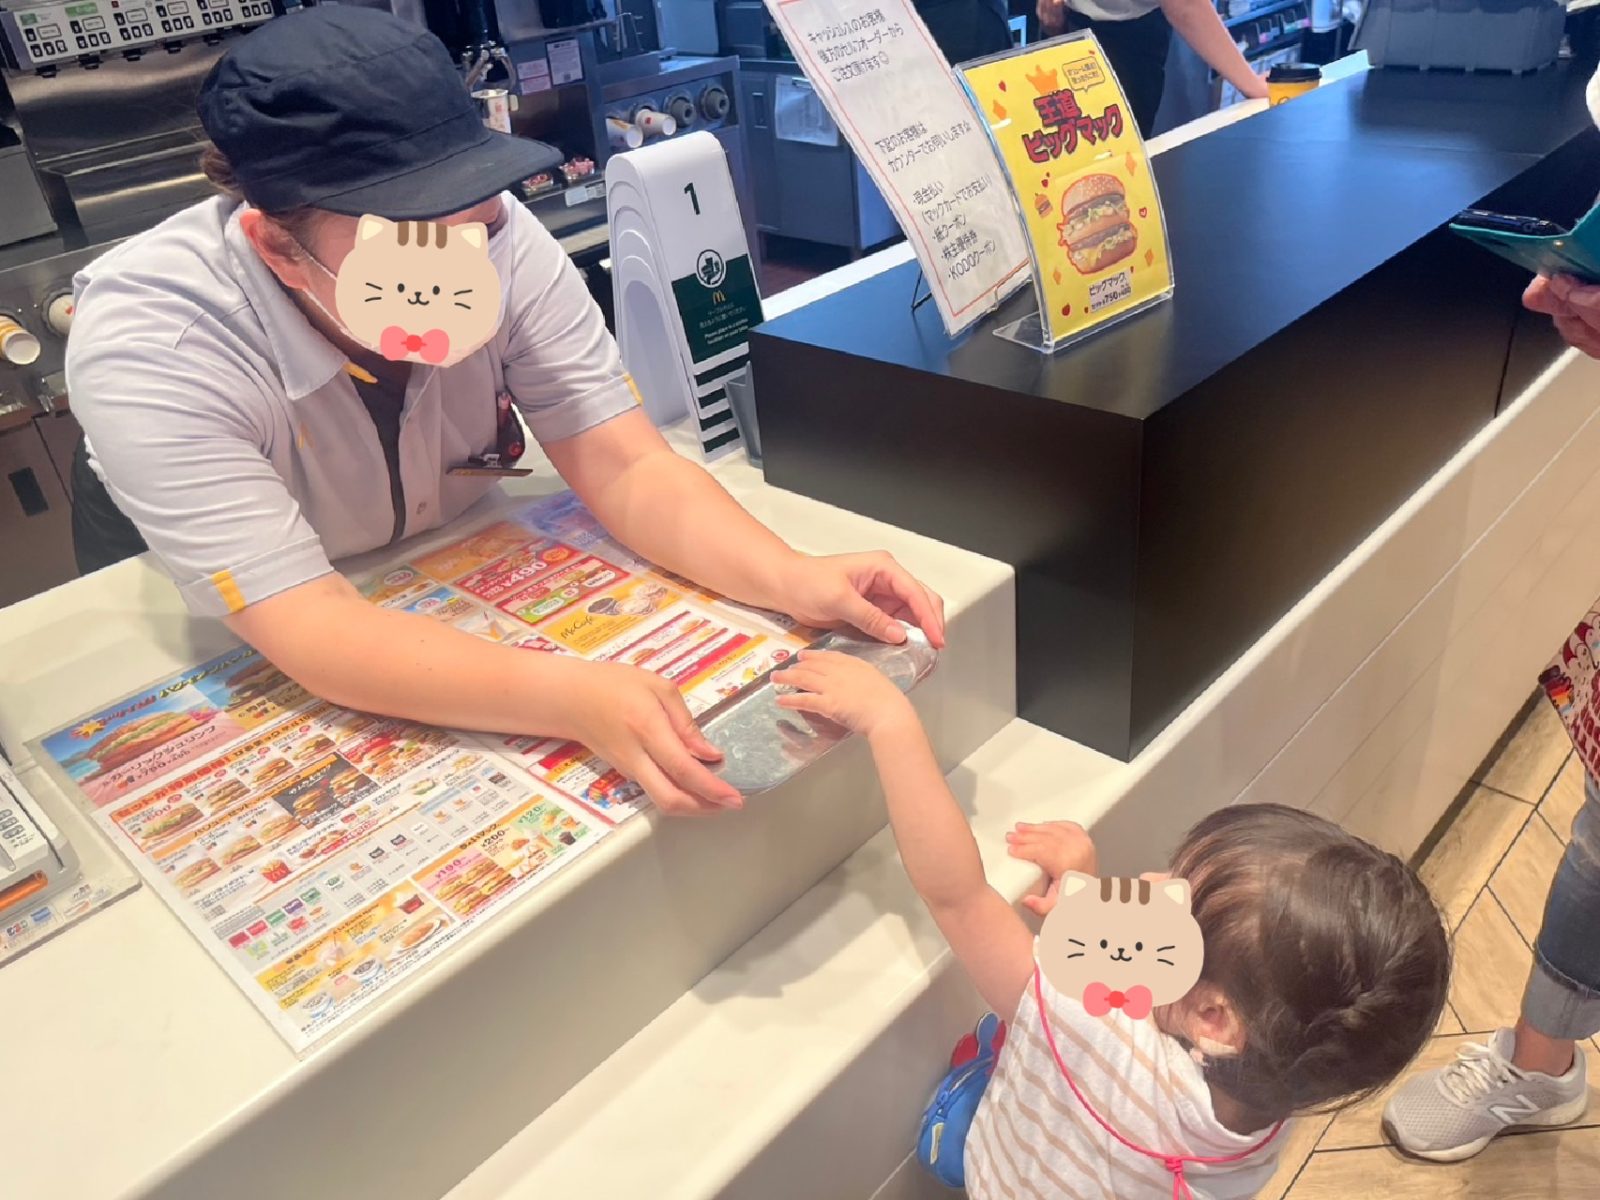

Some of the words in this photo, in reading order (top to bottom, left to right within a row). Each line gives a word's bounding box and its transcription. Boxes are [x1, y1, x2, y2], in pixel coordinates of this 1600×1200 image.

[1033, 89, 1082, 128] 王道
[1021, 104, 1123, 163] ビッグマック
[684, 181, 701, 216] 1
